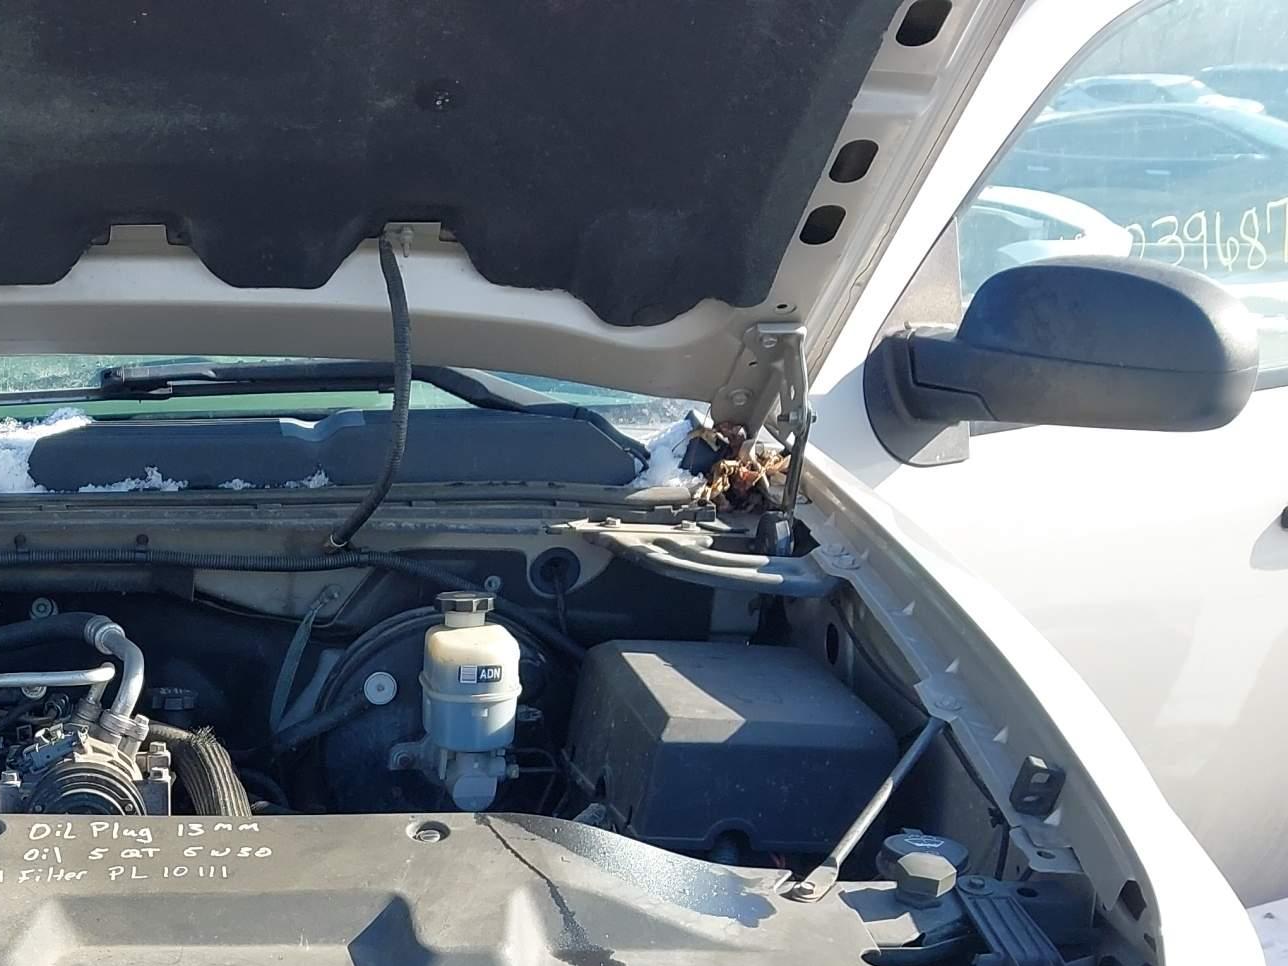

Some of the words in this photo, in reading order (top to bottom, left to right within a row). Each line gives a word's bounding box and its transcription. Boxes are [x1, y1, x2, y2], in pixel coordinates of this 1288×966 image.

[479, 667, 501, 680] ADN
[89, 822, 153, 844] Plug
[88, 847, 109, 860] 5
[18, 866, 88, 884] Filter
